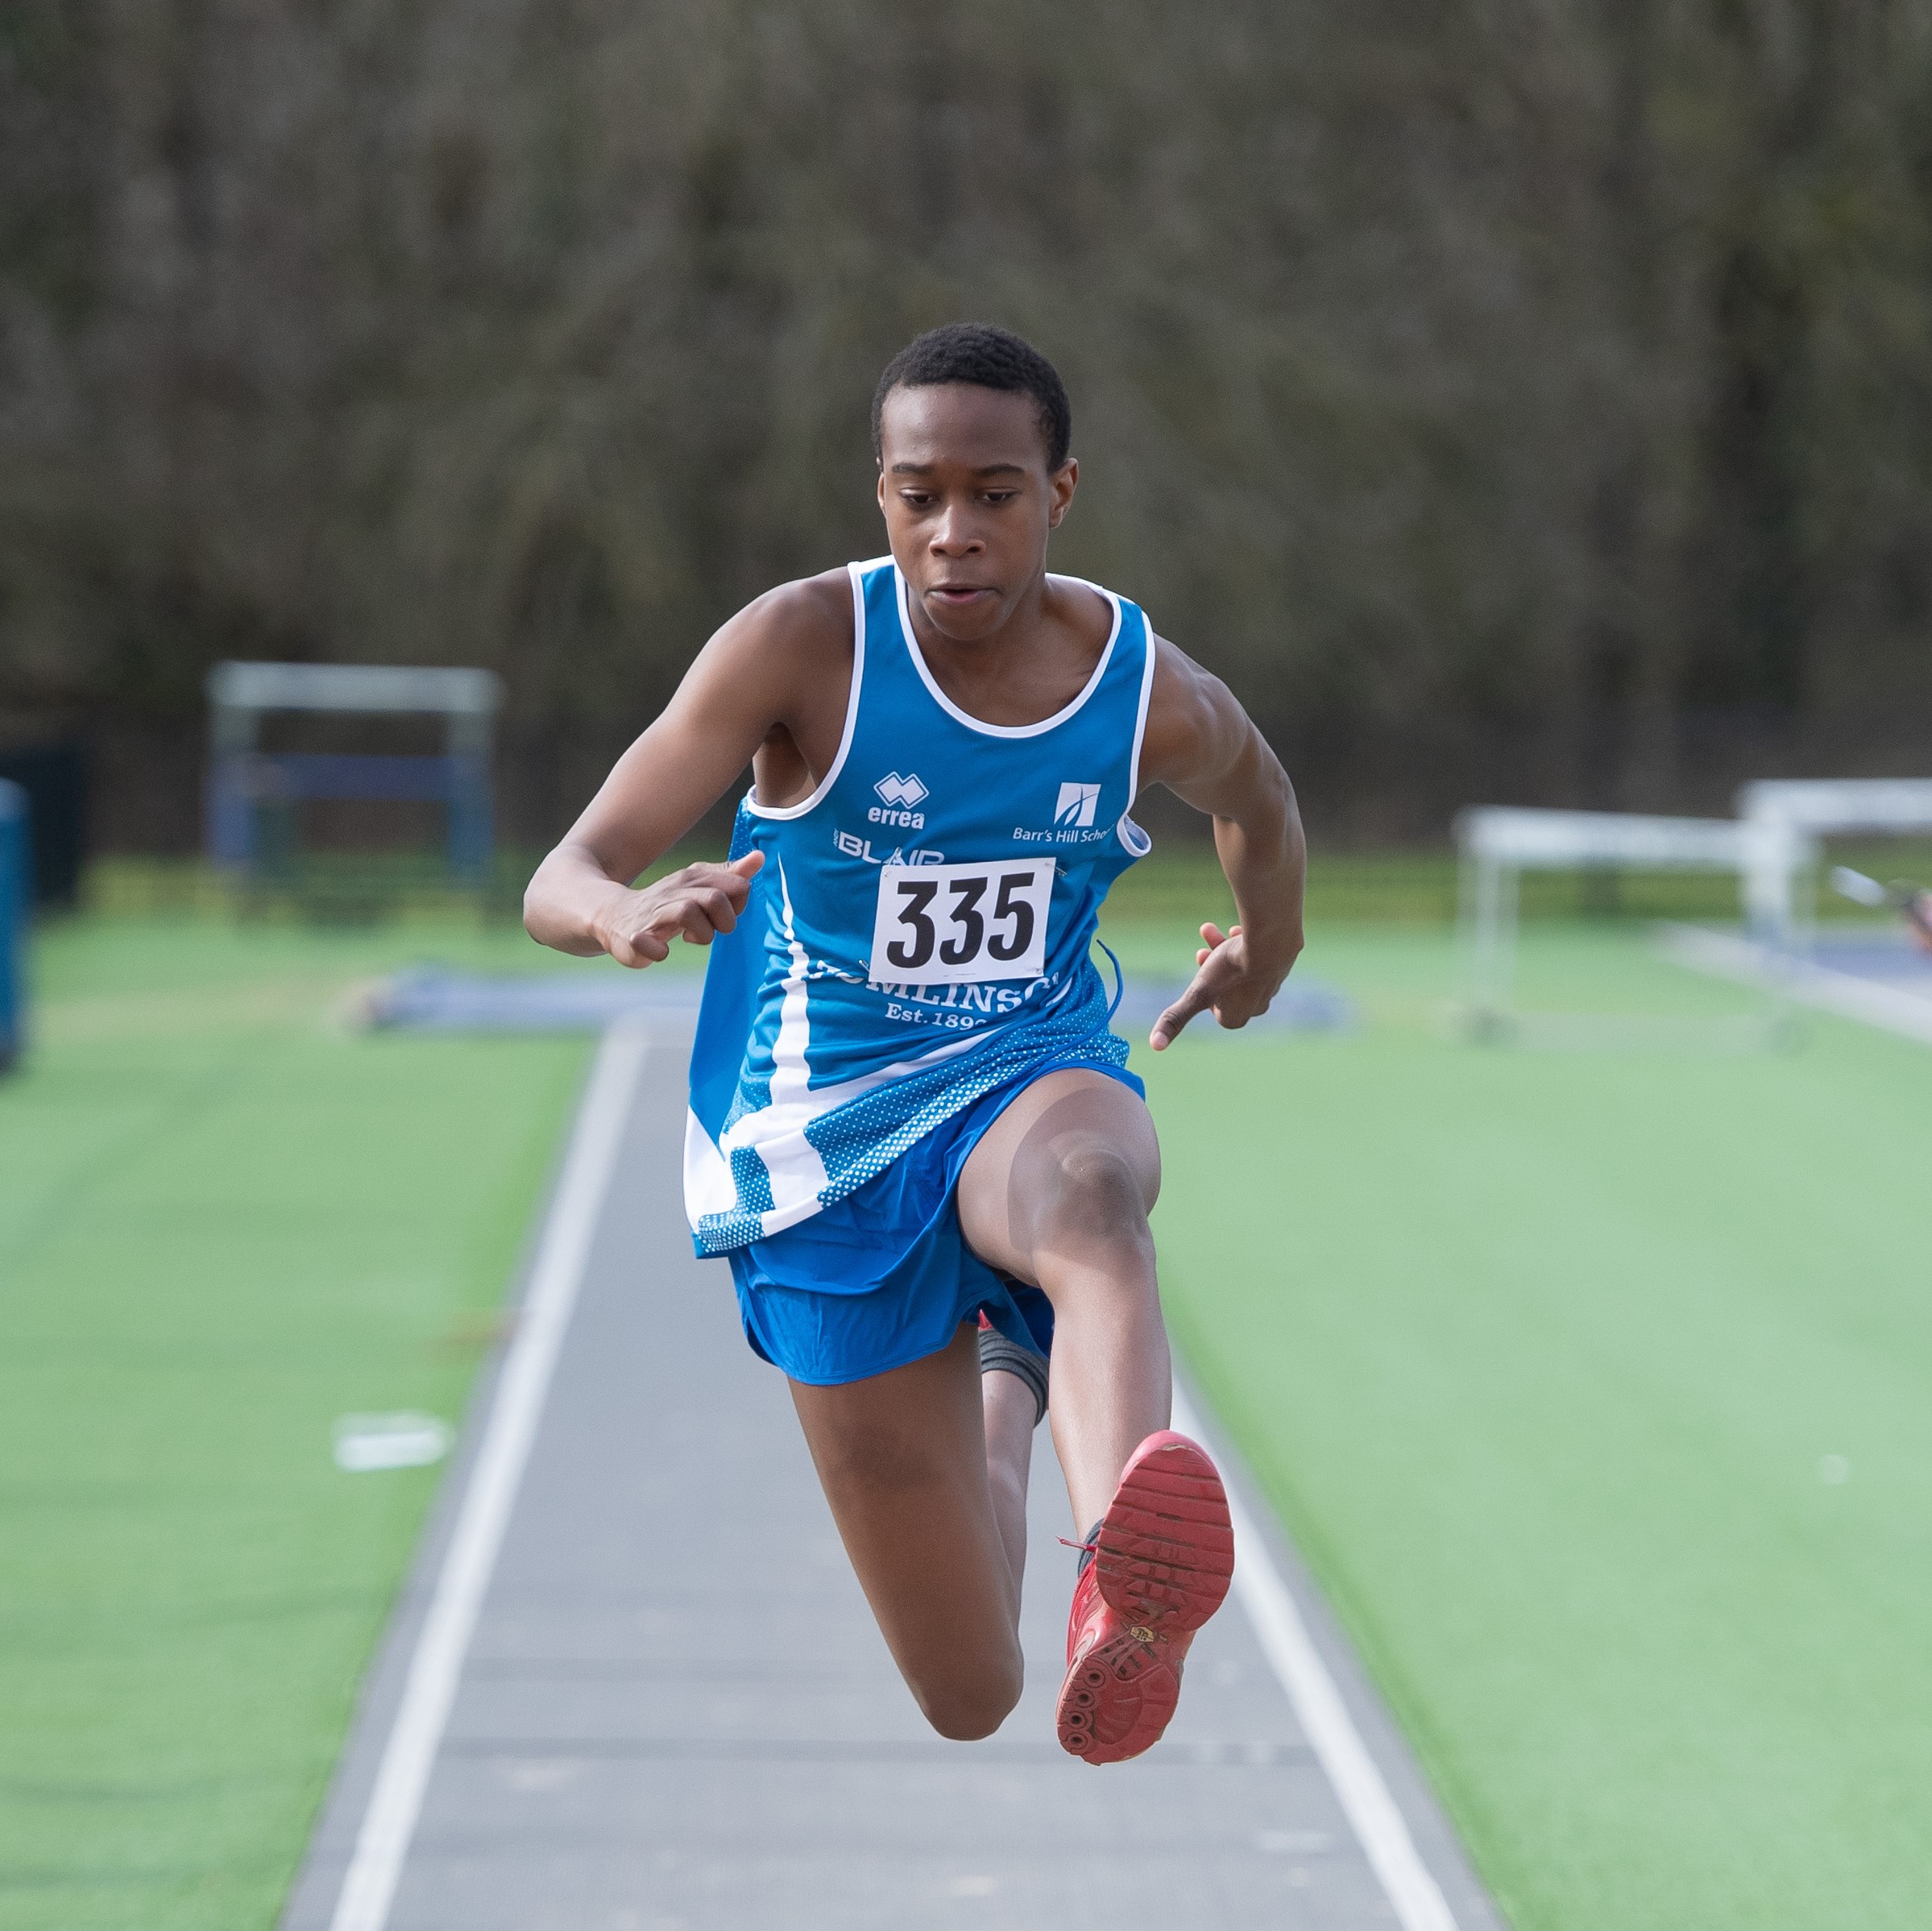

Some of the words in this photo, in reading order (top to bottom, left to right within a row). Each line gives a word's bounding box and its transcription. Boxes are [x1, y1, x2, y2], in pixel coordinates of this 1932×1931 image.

[1013, 827, 1052, 842] Barr's
[1055, 829, 1079, 843] Hill
[887, 872, 1035, 969] 335
